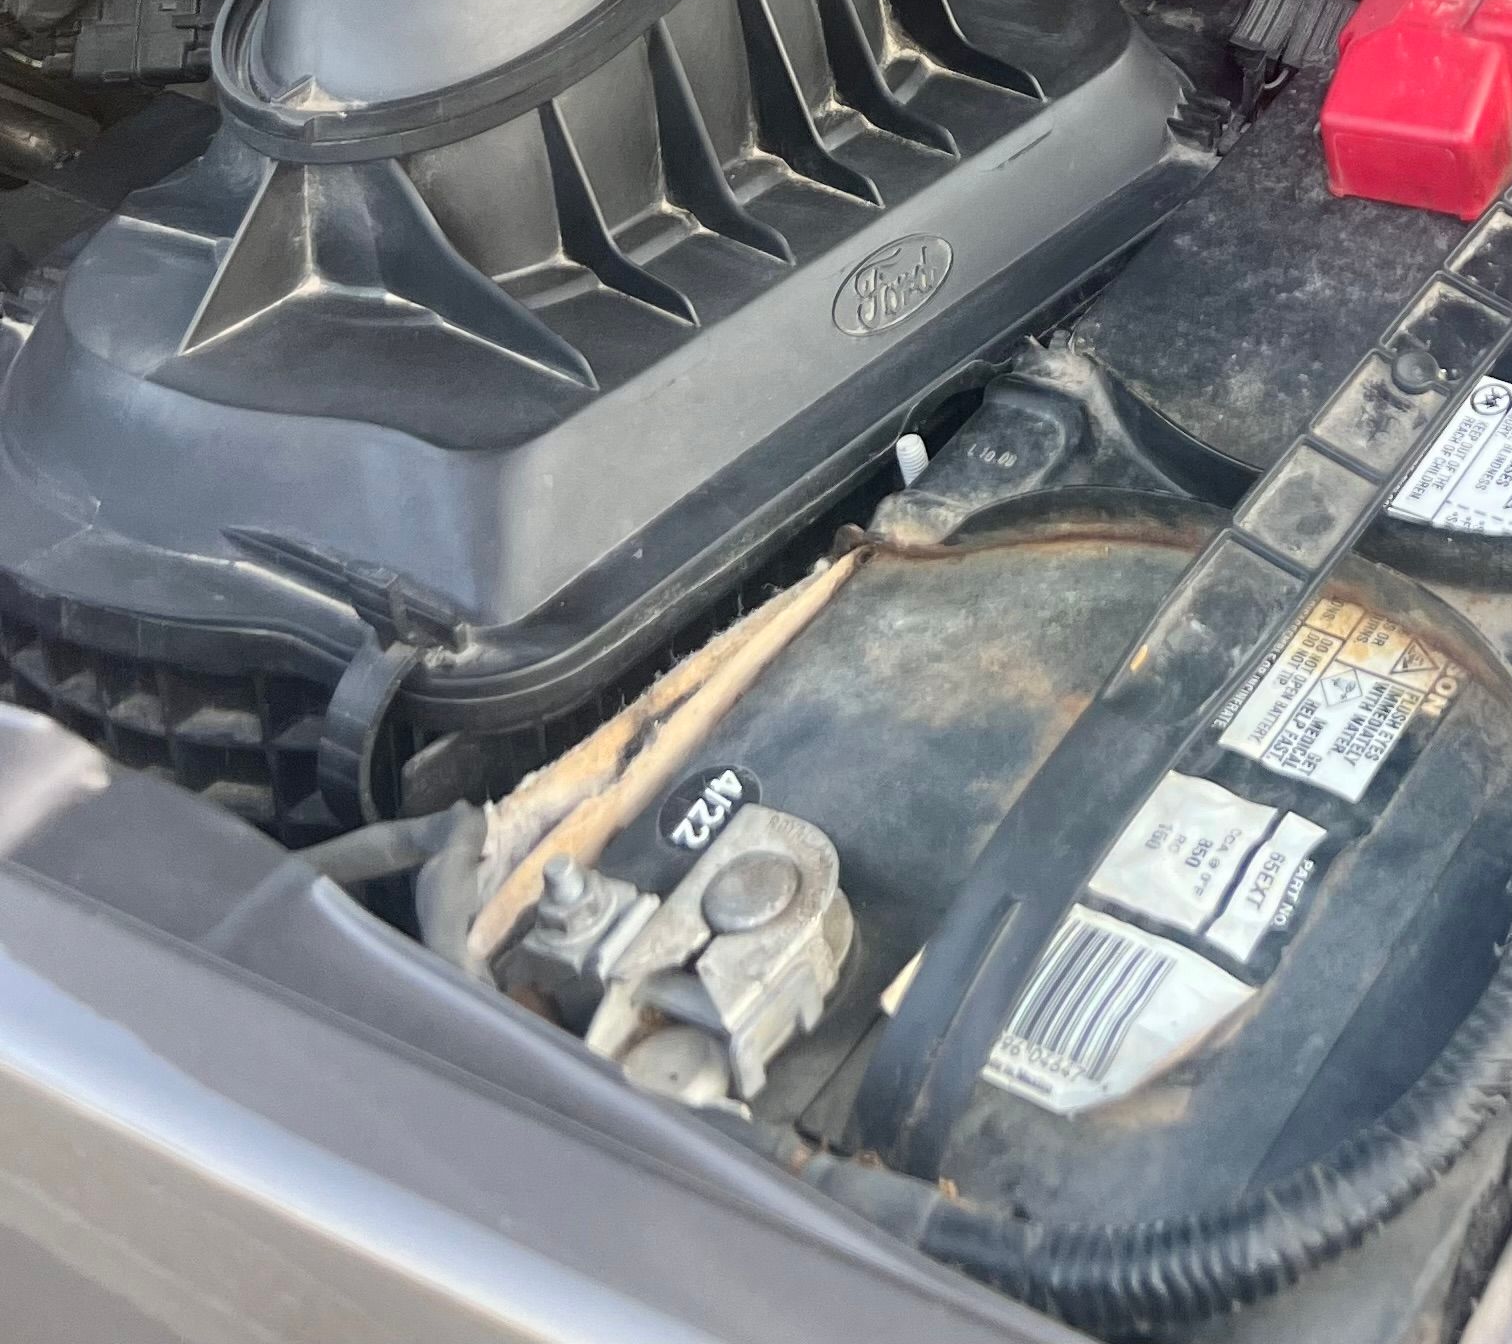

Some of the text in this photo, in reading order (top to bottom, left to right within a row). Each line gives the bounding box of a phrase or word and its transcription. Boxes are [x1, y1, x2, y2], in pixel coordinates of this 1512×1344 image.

[849, 245, 937, 331] Ford
[1447, 414, 1475, 445] REACH
[1431, 419, 1488, 491] KEEP OUT OF THE
[1438, 443, 1455, 458] OF
[1473, 443, 1512, 492] BLINDNESS
[1287, 648, 1308, 668] NOT
[1301, 631, 1320, 649] DO
[1314, 638, 1332, 654] DO
[1299, 653, 1321, 674] NOT
[1280, 674, 1306, 700] OPEN
[1358, 681, 1387, 713] WITH
[1265, 698, 1320, 762] HELP FAST.
[1280, 717, 1327, 771] MEDICAL
[1343, 686, 1403, 767] IMMEDIATELY
[1364, 691, 1419, 763] FLUSH EYES
[1297, 751, 1321, 776] GET
[1242, 849, 1287, 910] 65EXT
[1268, 857, 1314, 929] PART NO.
